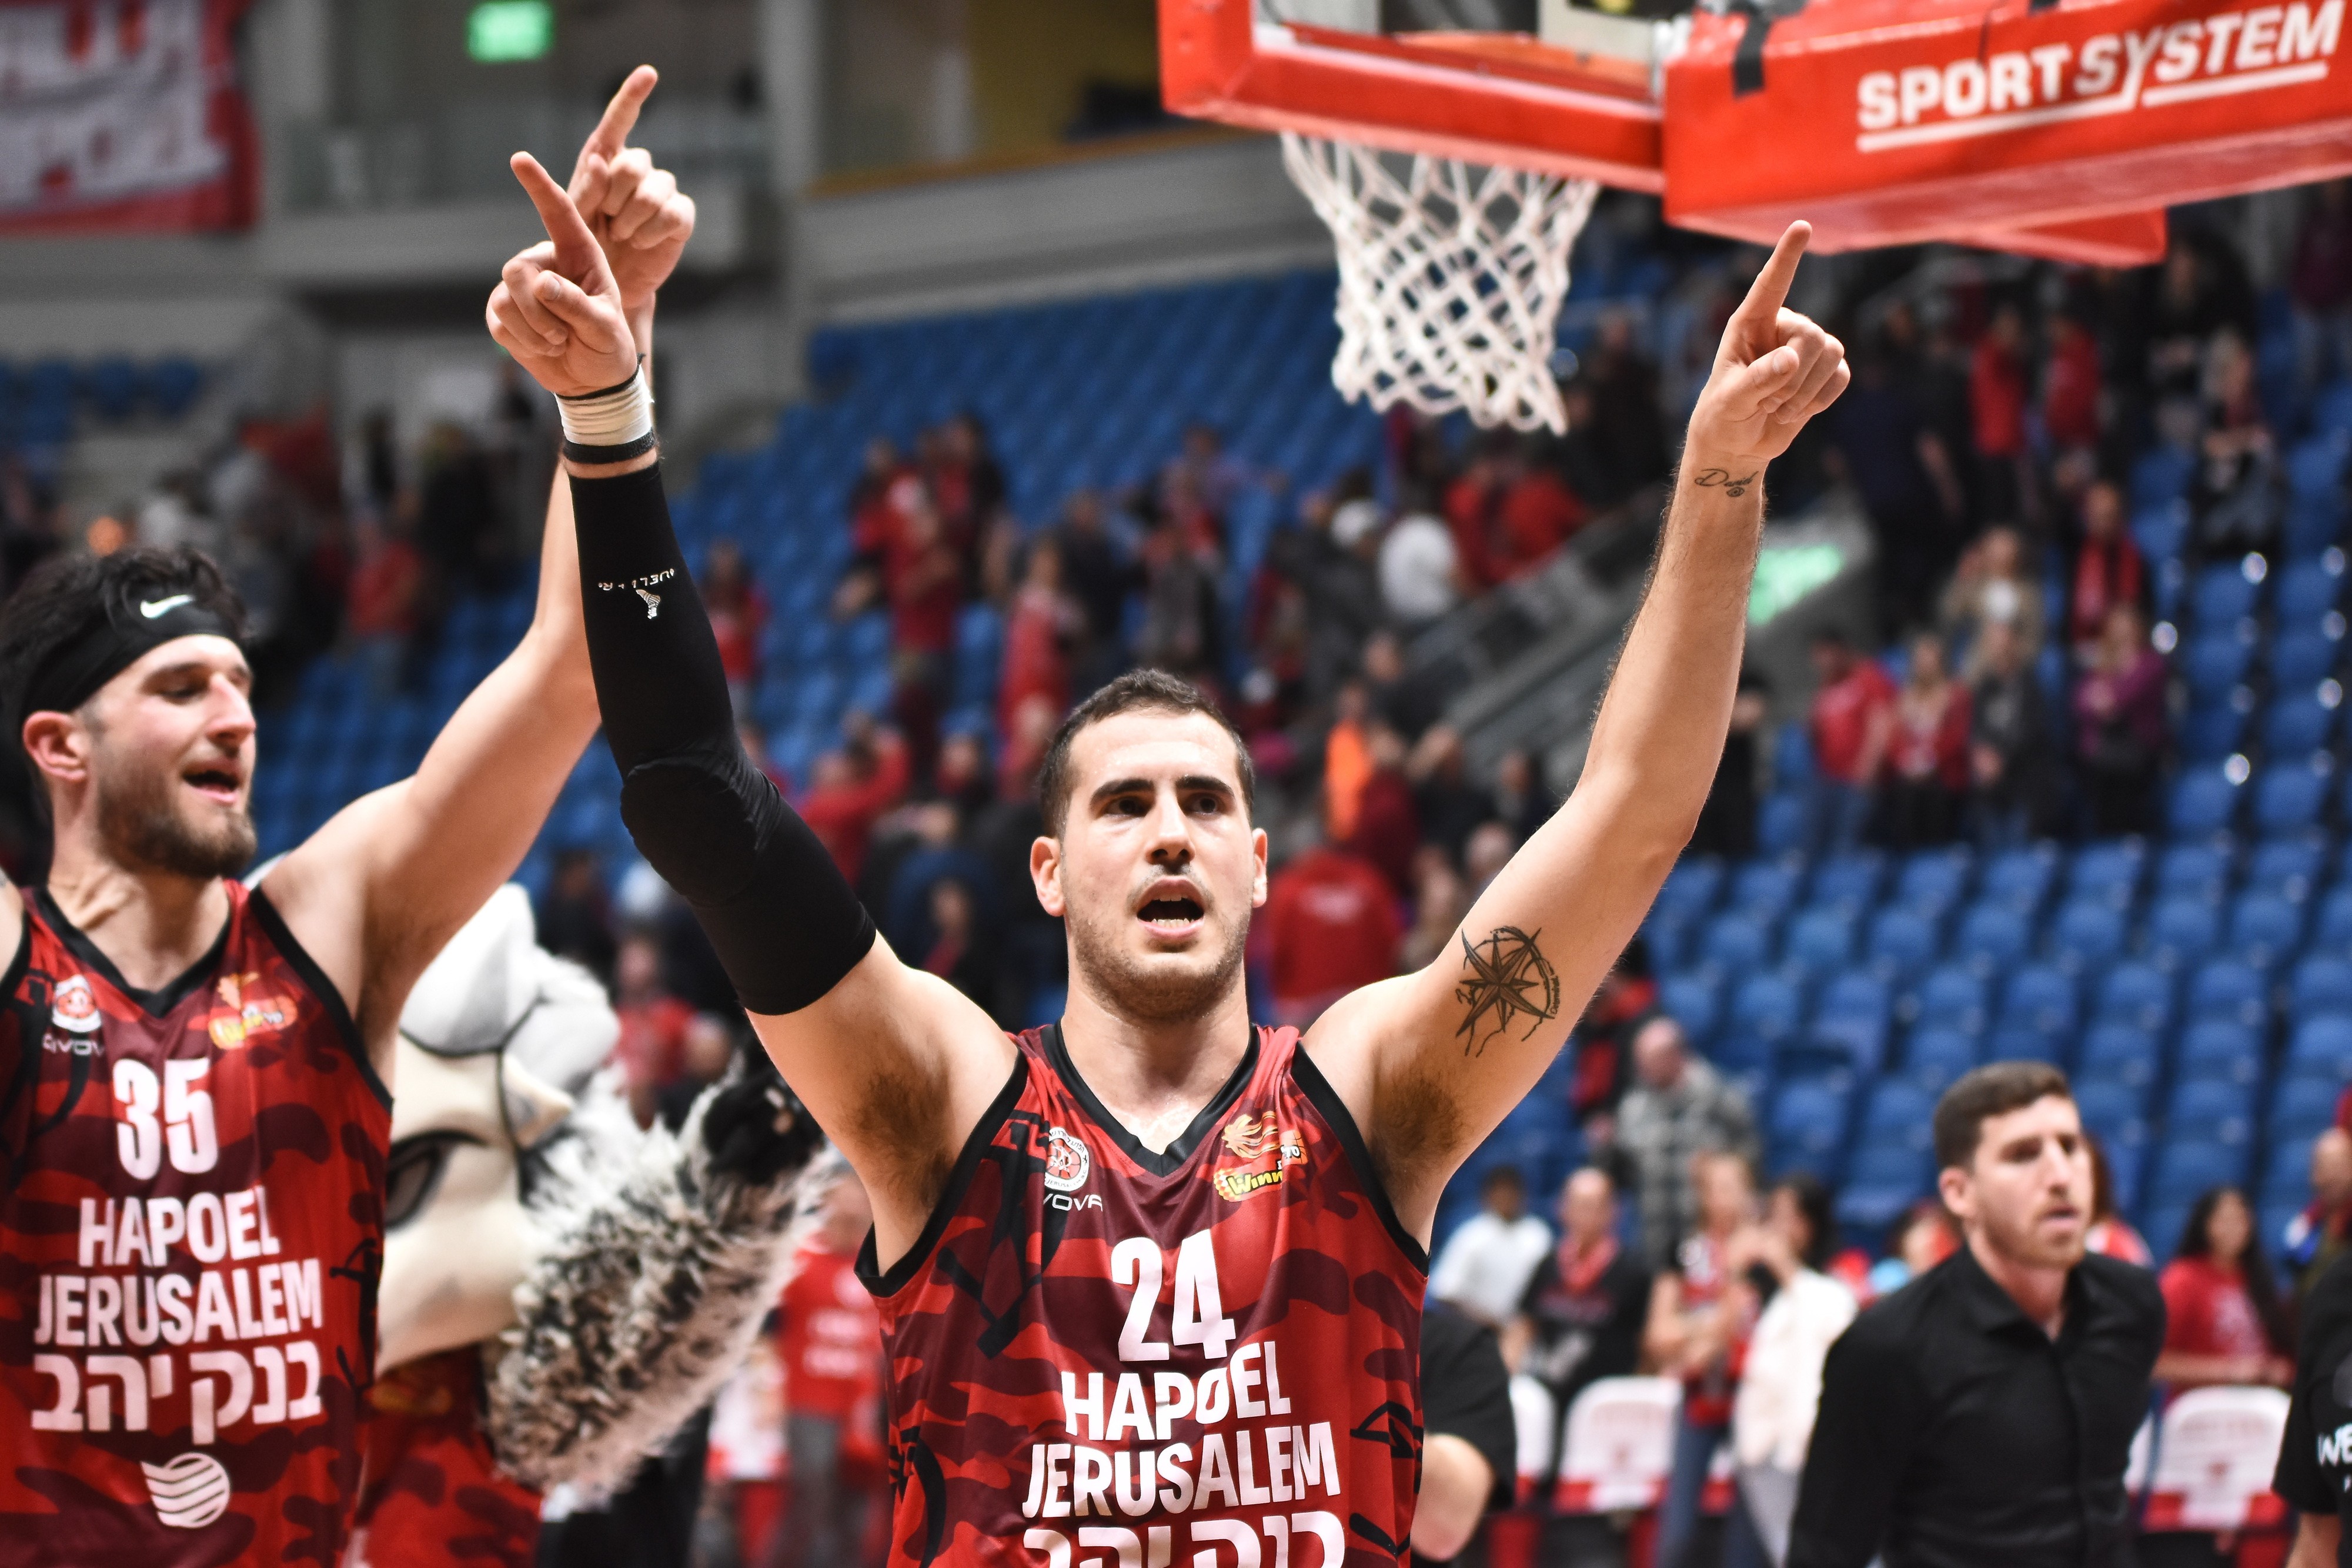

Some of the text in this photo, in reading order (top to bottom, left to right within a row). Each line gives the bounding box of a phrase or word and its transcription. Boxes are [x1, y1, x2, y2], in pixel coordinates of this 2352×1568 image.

[112, 1058, 218, 1181] 35
[79, 1186, 280, 1268] HAPOEL
[1227, 1171, 1282, 1195] Winn
[34, 1258, 323, 1347] JERUSALEM
[1111, 1229, 1236, 1362] 24
[31, 1340, 322, 1445] בנק יהב
[1061, 1341, 1291, 1440] HAPOEL
[1022, 1422, 1341, 1518] JERUSALEM
